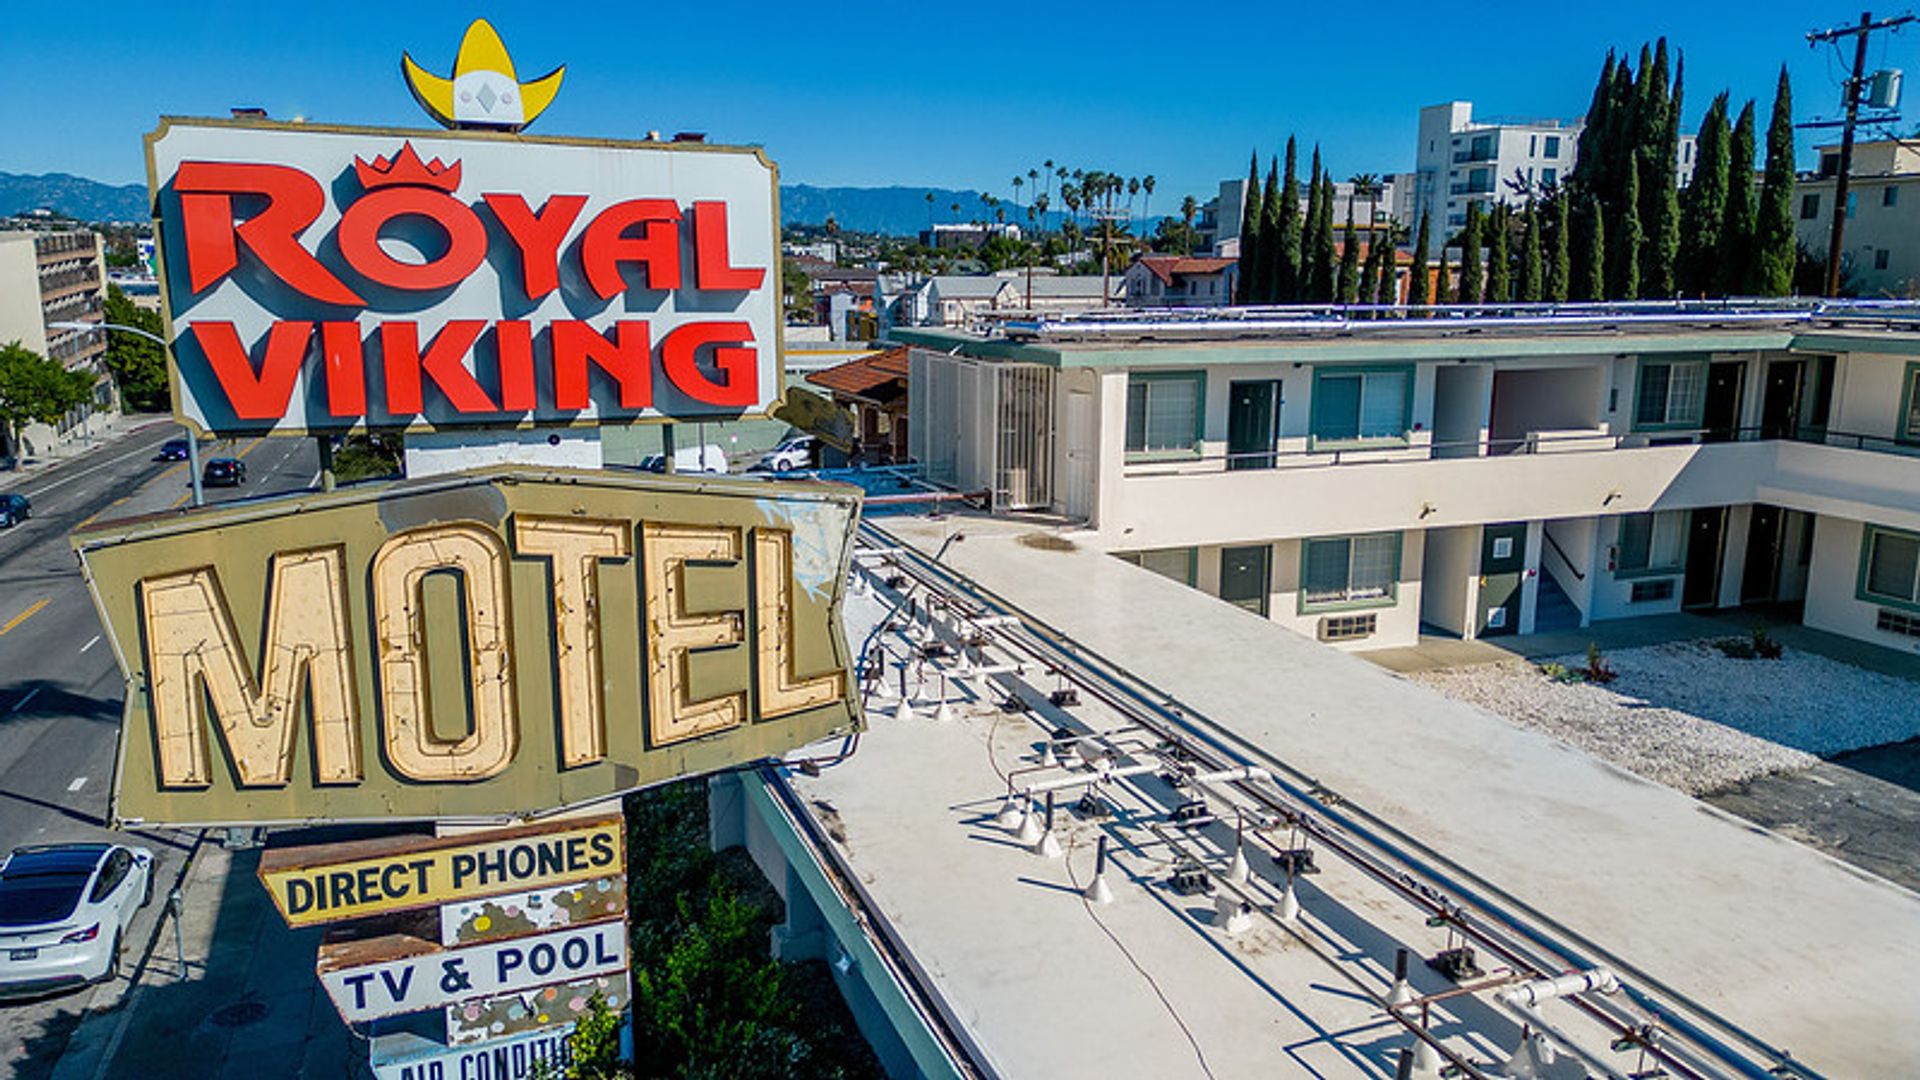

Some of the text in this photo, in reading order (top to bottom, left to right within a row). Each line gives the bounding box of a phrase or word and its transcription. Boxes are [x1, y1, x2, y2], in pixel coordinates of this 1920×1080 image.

[174, 162, 766, 306] ROYAL
[191, 320, 760, 420] VIKING
[139, 514, 846, 788] MOTEL
[286, 833, 614, 915] DIRECT PHONES
[344, 932, 619, 1009] TV & POOL
